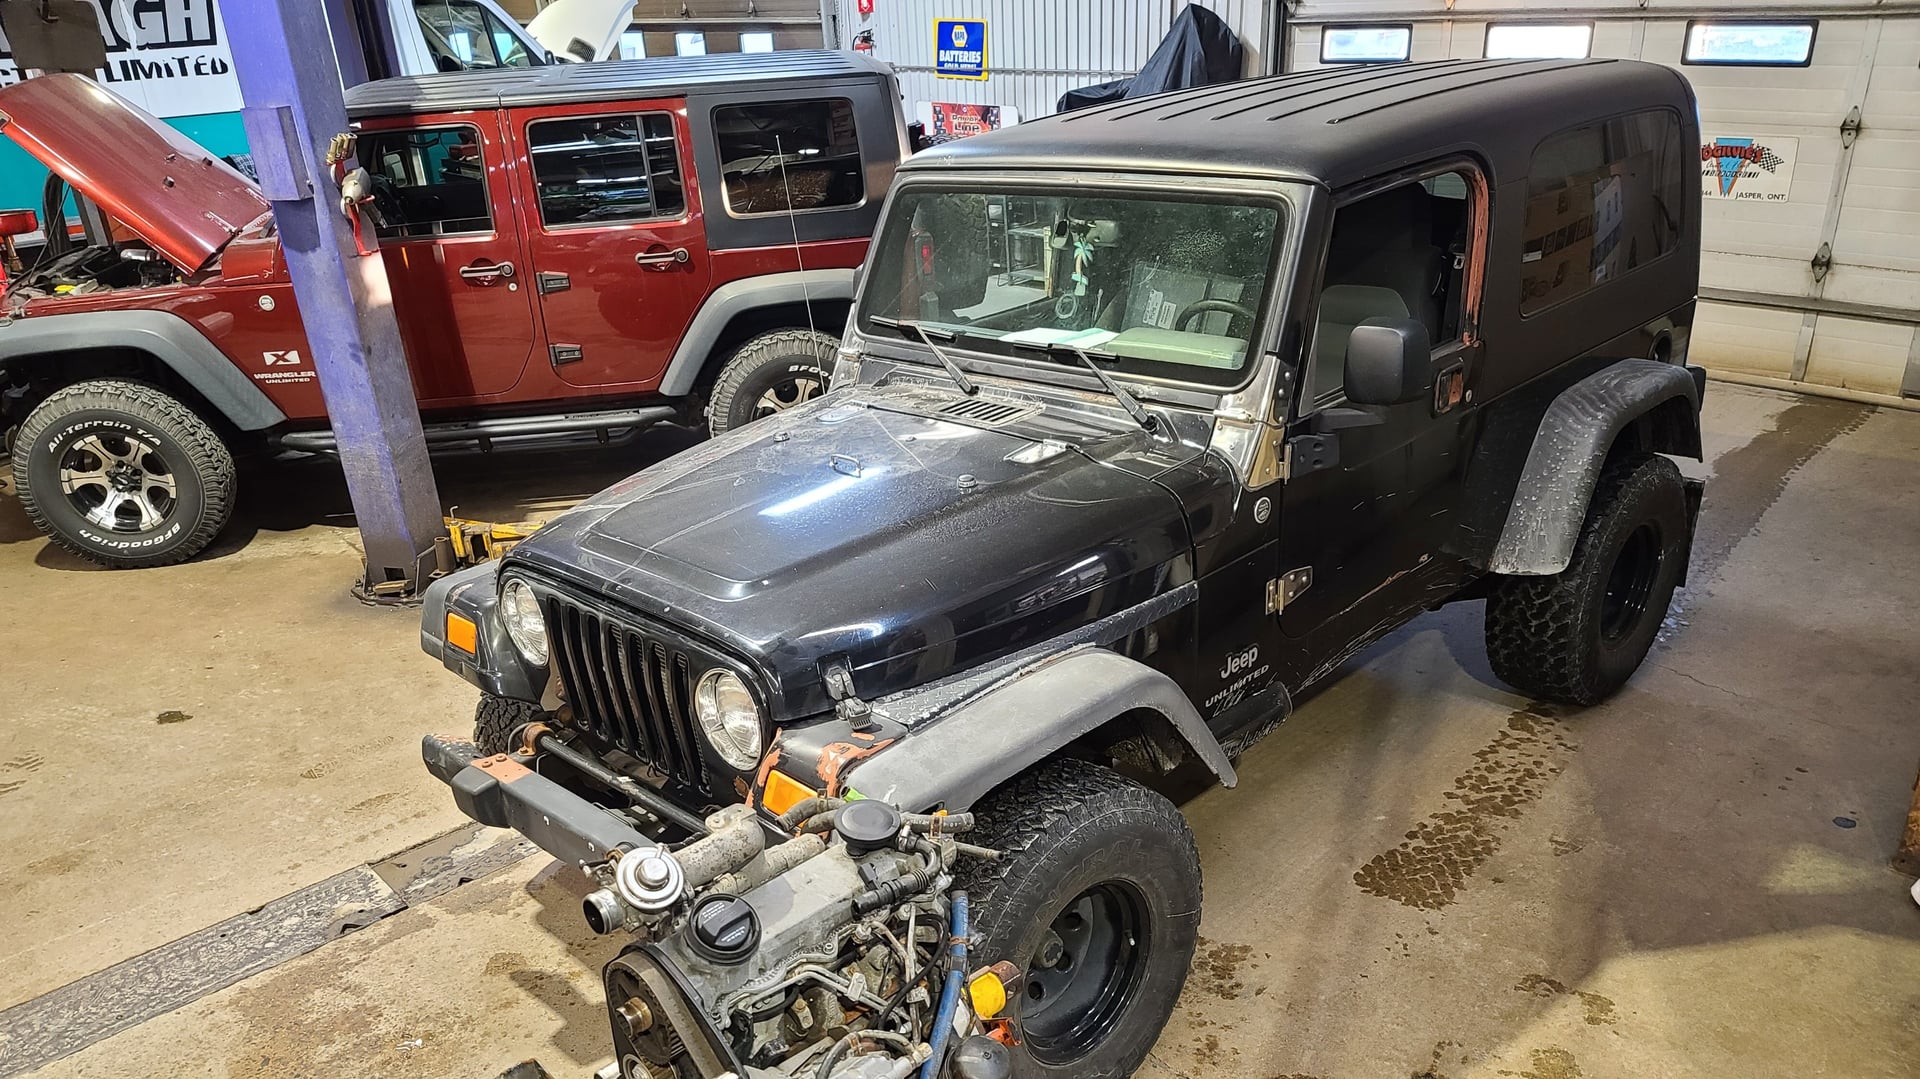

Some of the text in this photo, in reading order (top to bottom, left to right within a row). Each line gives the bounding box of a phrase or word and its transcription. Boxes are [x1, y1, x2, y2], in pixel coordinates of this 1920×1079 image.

[939, 50, 981, 63] BATTERIES
[1735, 191, 1764, 200] JASPER,
[254, 371, 316, 379] WRANGLER
[48, 420, 162, 453] All-Terrain T/A
[79, 523, 181, 549] BFGoodrich
[1221, 647, 1258, 679] Jeep
[1205, 664, 1270, 708] UNLIMITED
